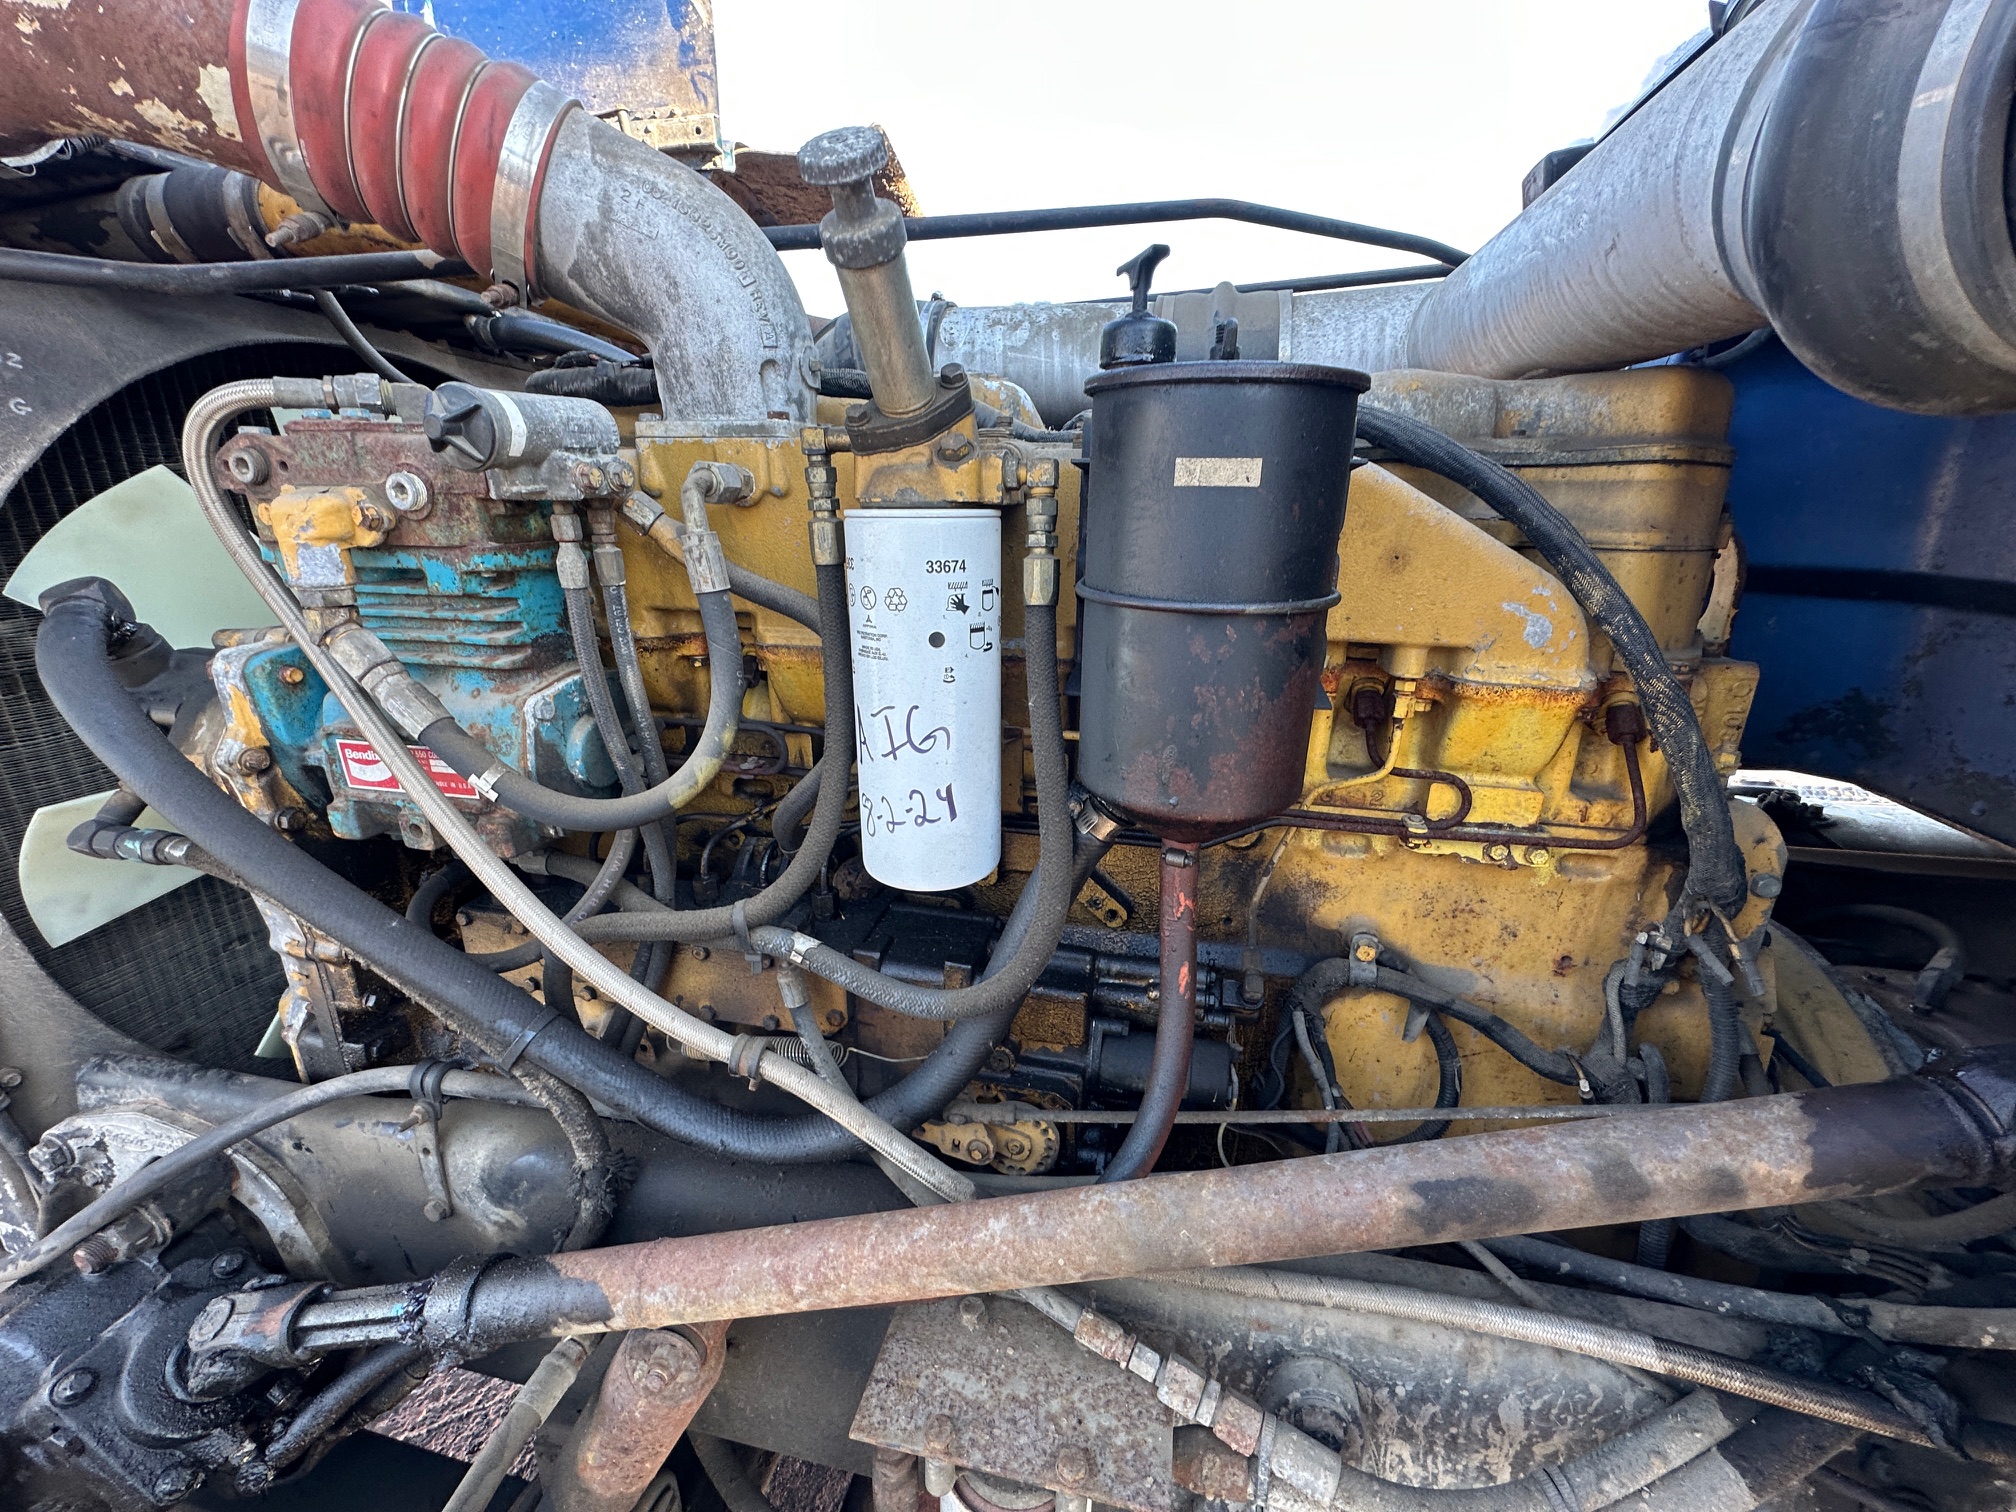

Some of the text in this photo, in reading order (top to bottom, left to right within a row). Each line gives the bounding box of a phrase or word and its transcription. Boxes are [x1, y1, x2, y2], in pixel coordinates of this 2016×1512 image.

[925, 559, 967, 574] 33674
[344, 748, 381, 761] Bendix
[861, 782, 958, 838] 8-2-24
